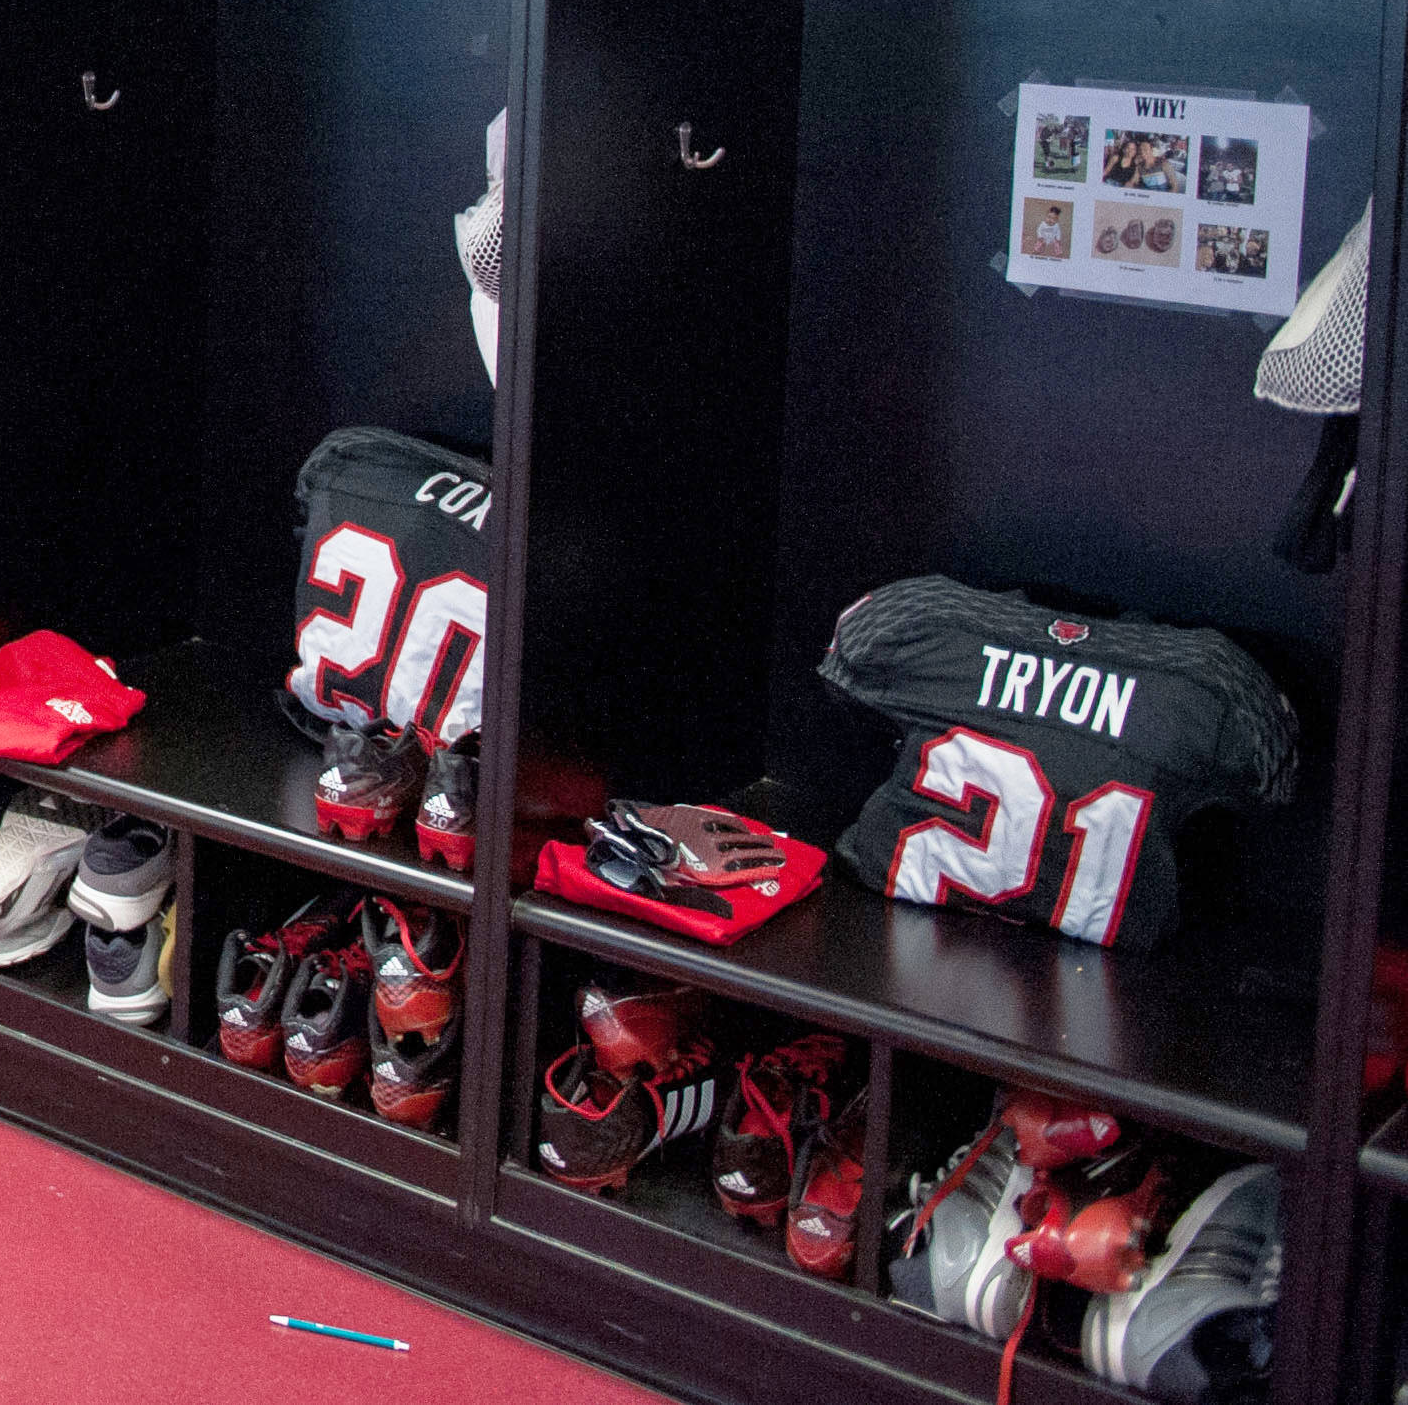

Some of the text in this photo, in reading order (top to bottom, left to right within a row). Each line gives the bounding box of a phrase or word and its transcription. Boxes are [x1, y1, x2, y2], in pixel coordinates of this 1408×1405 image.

[1134, 95, 1186, 120] WHY!
[286, 519, 488, 747] 20
[977, 644, 1138, 740] TRYON
[323, 787, 339, 804] 20
[428, 811, 449, 830] 20
[885, 724, 1157, 948] 21
